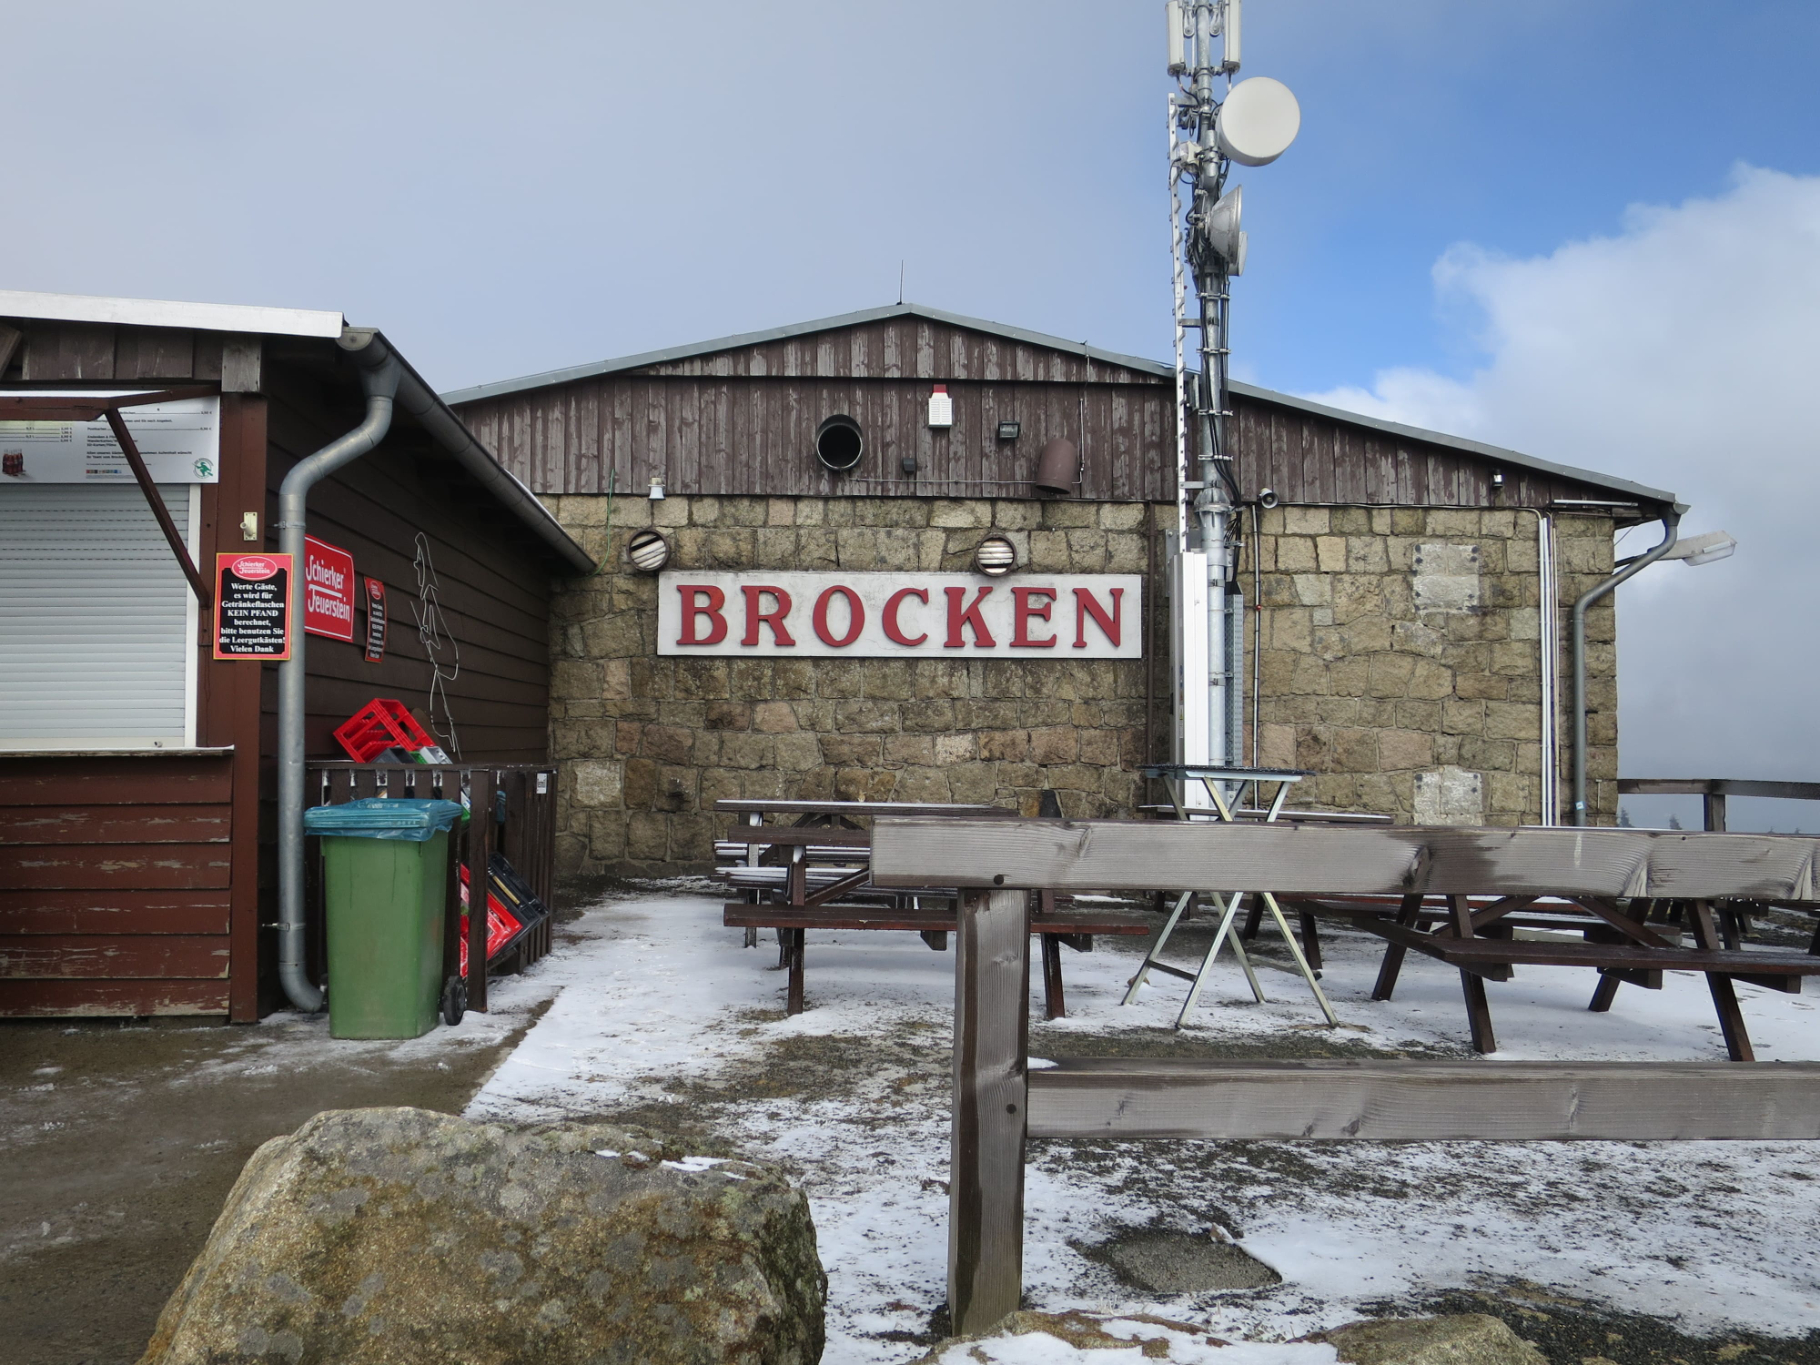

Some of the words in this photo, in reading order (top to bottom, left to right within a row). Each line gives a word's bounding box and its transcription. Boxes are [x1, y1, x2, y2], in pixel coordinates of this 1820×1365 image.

[254, 583, 277, 591] Gäste,
[305, 554, 344, 590] Schierker
[308, 584, 350, 622] Feuerstein
[675, 584, 1124, 648] BROCKEN
[232, 636, 286, 645] Leergutkästen!
